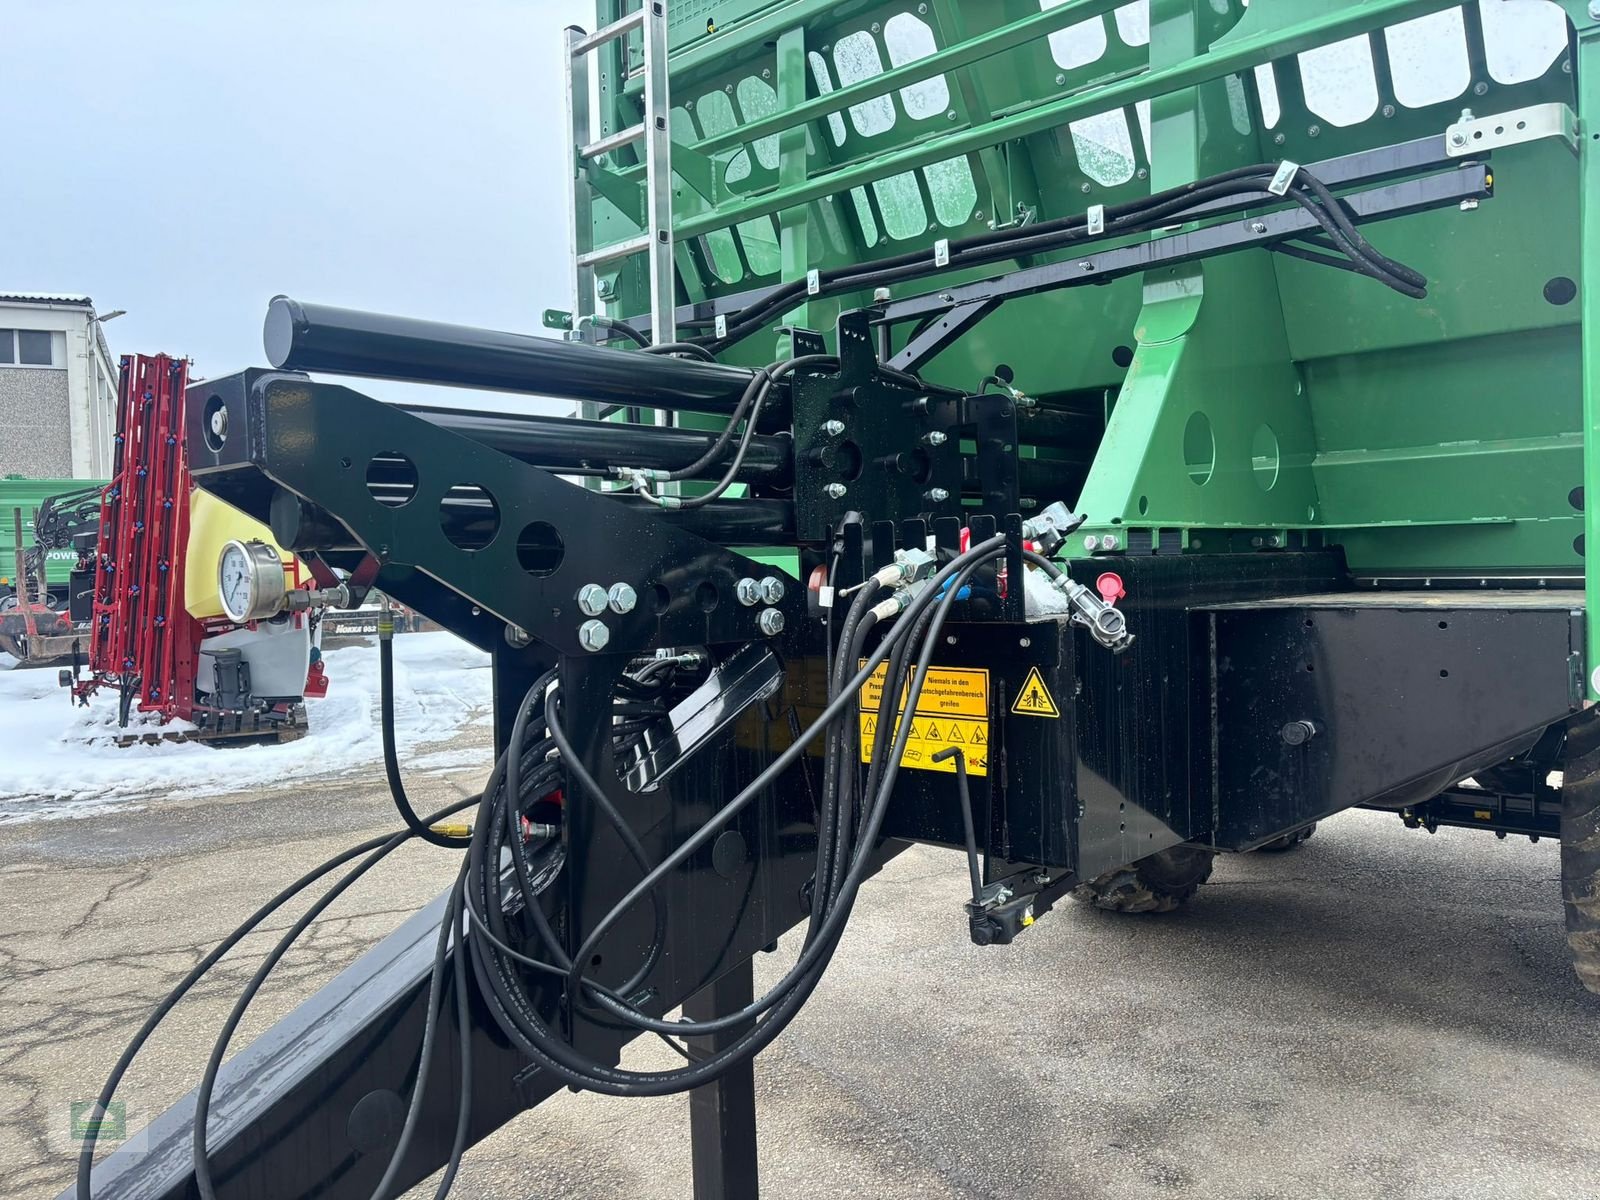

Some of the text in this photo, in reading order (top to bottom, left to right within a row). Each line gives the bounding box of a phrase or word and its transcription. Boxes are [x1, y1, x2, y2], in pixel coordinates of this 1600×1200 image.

[46, 552, 79, 560] POWE
[928, 677, 951, 685] Niemals
[952, 678, 957, 686] in
[940, 699, 959, 707] greifen
